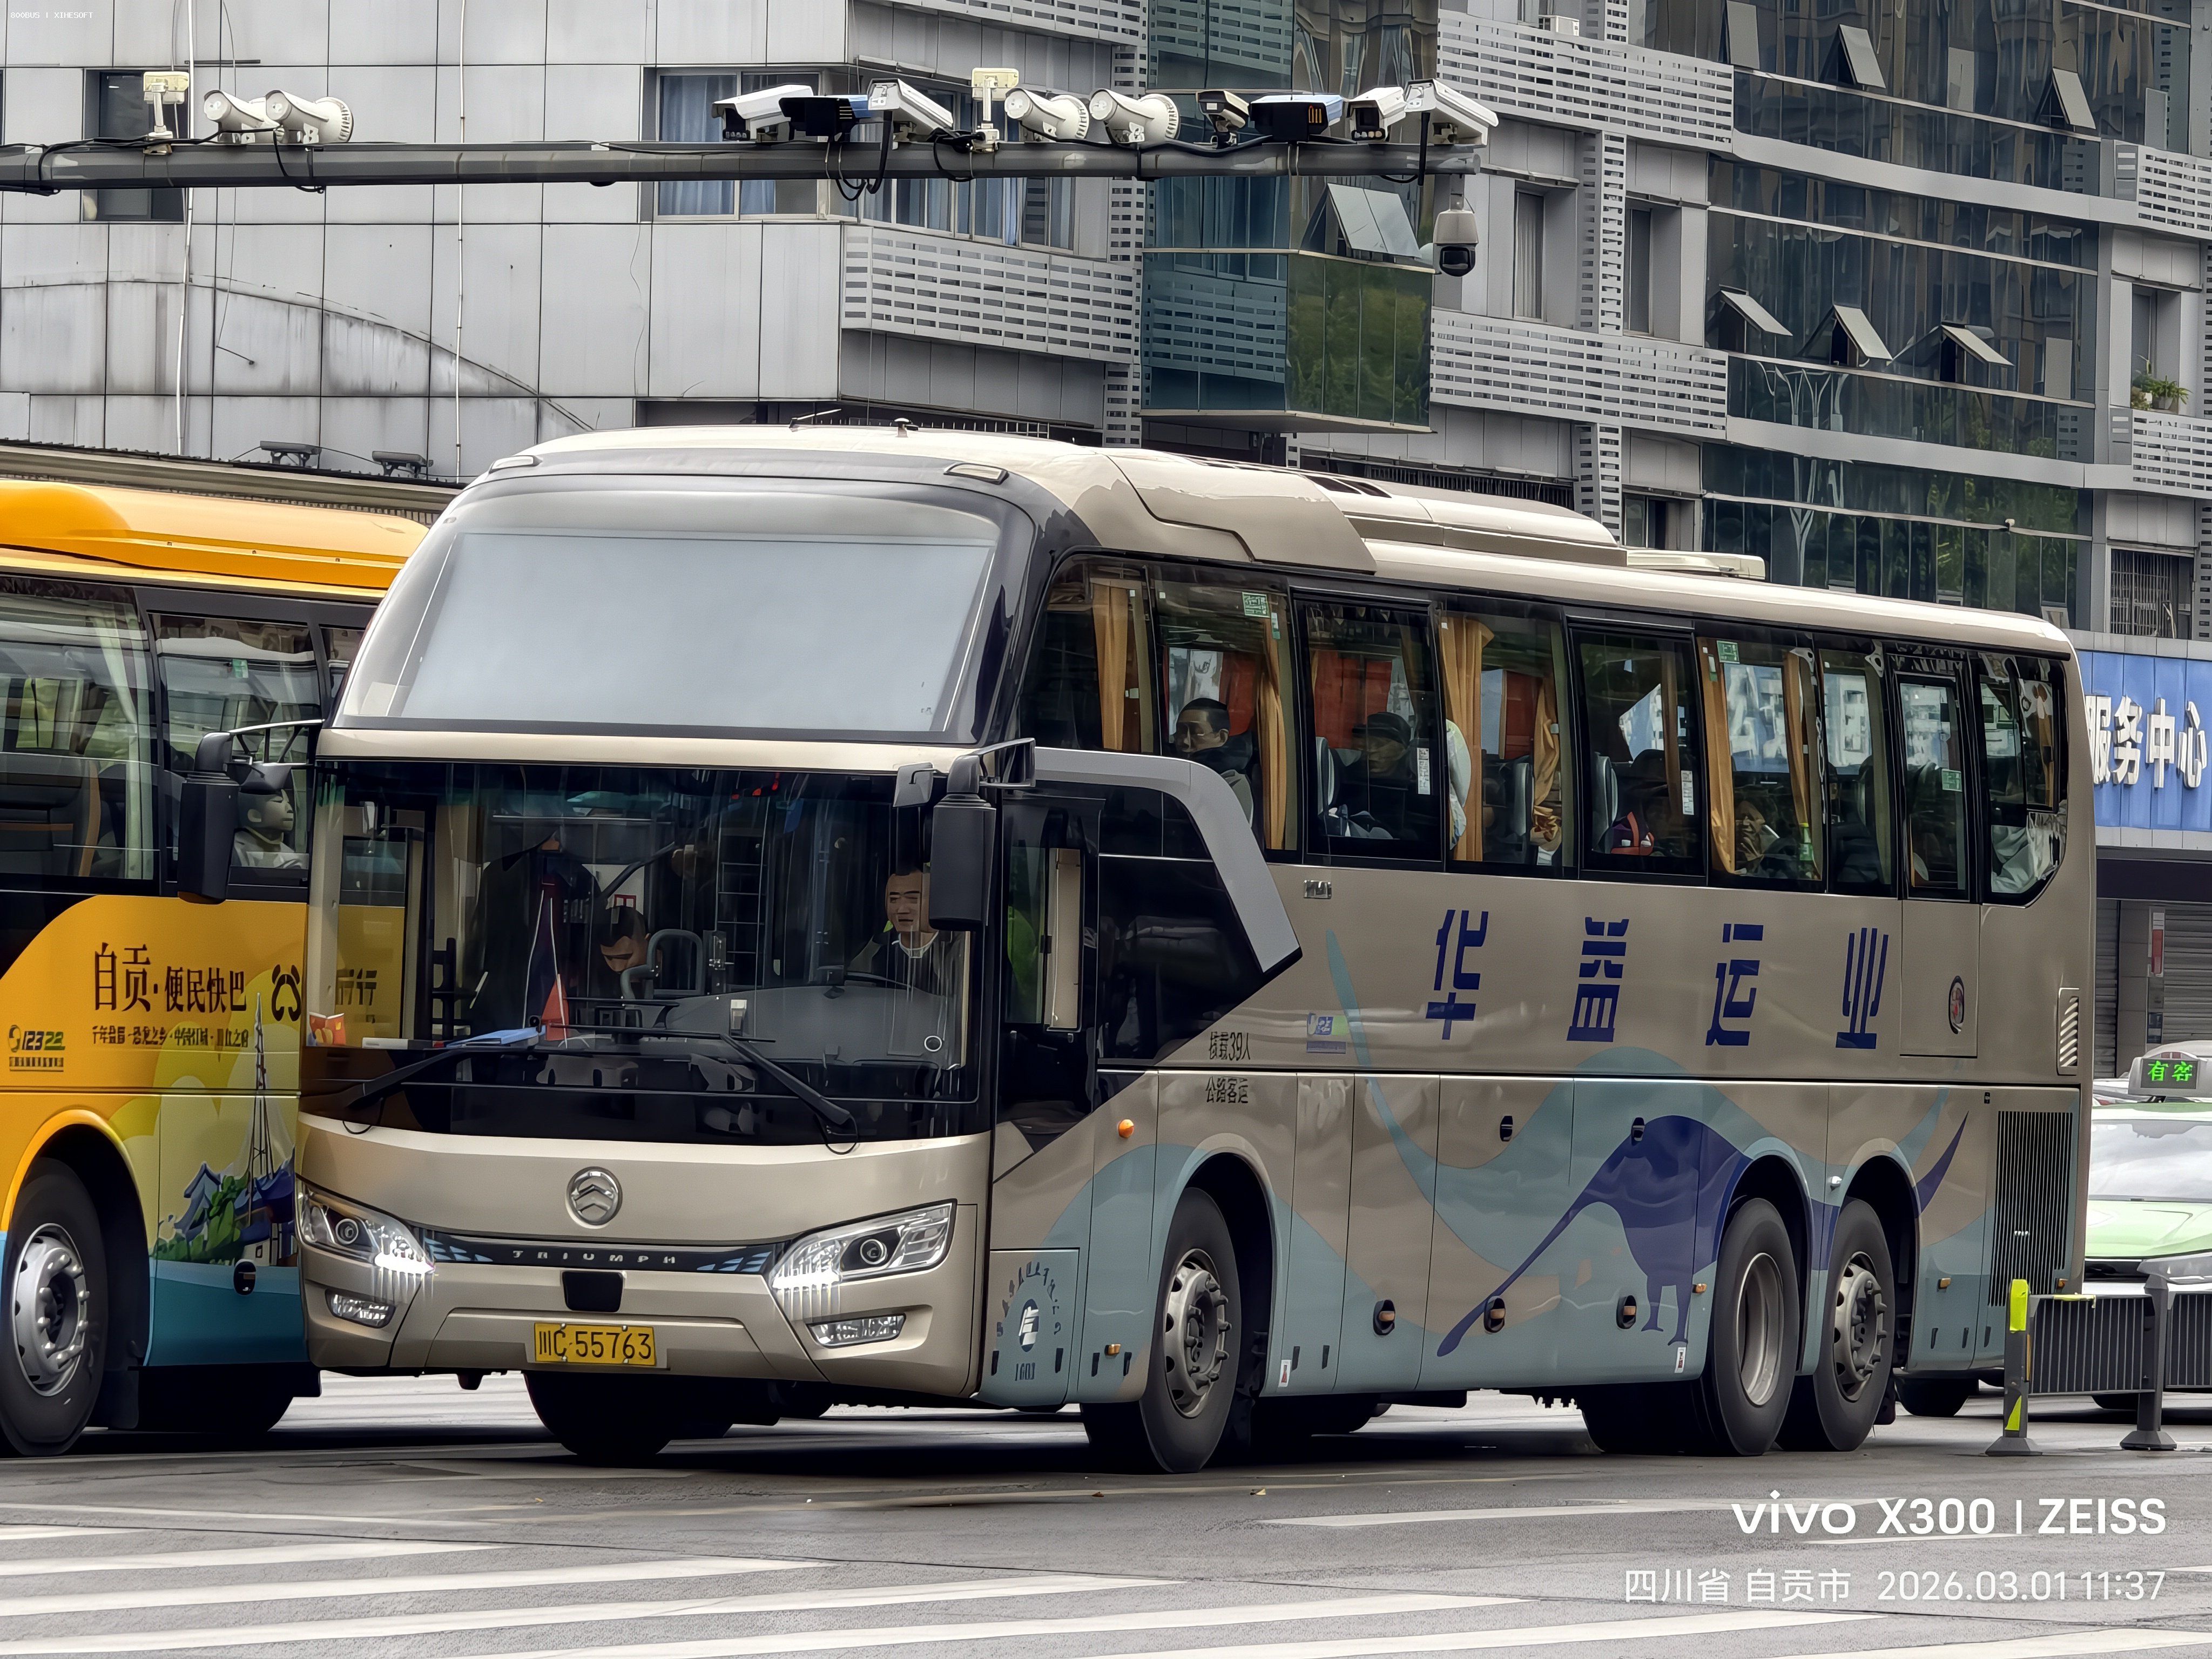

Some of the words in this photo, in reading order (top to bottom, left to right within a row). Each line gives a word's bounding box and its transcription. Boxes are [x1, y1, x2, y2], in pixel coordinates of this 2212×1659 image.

[2085, 694, 2207, 788] 服务中心
[512, 1250, 676, 1264] TRIUMPH
